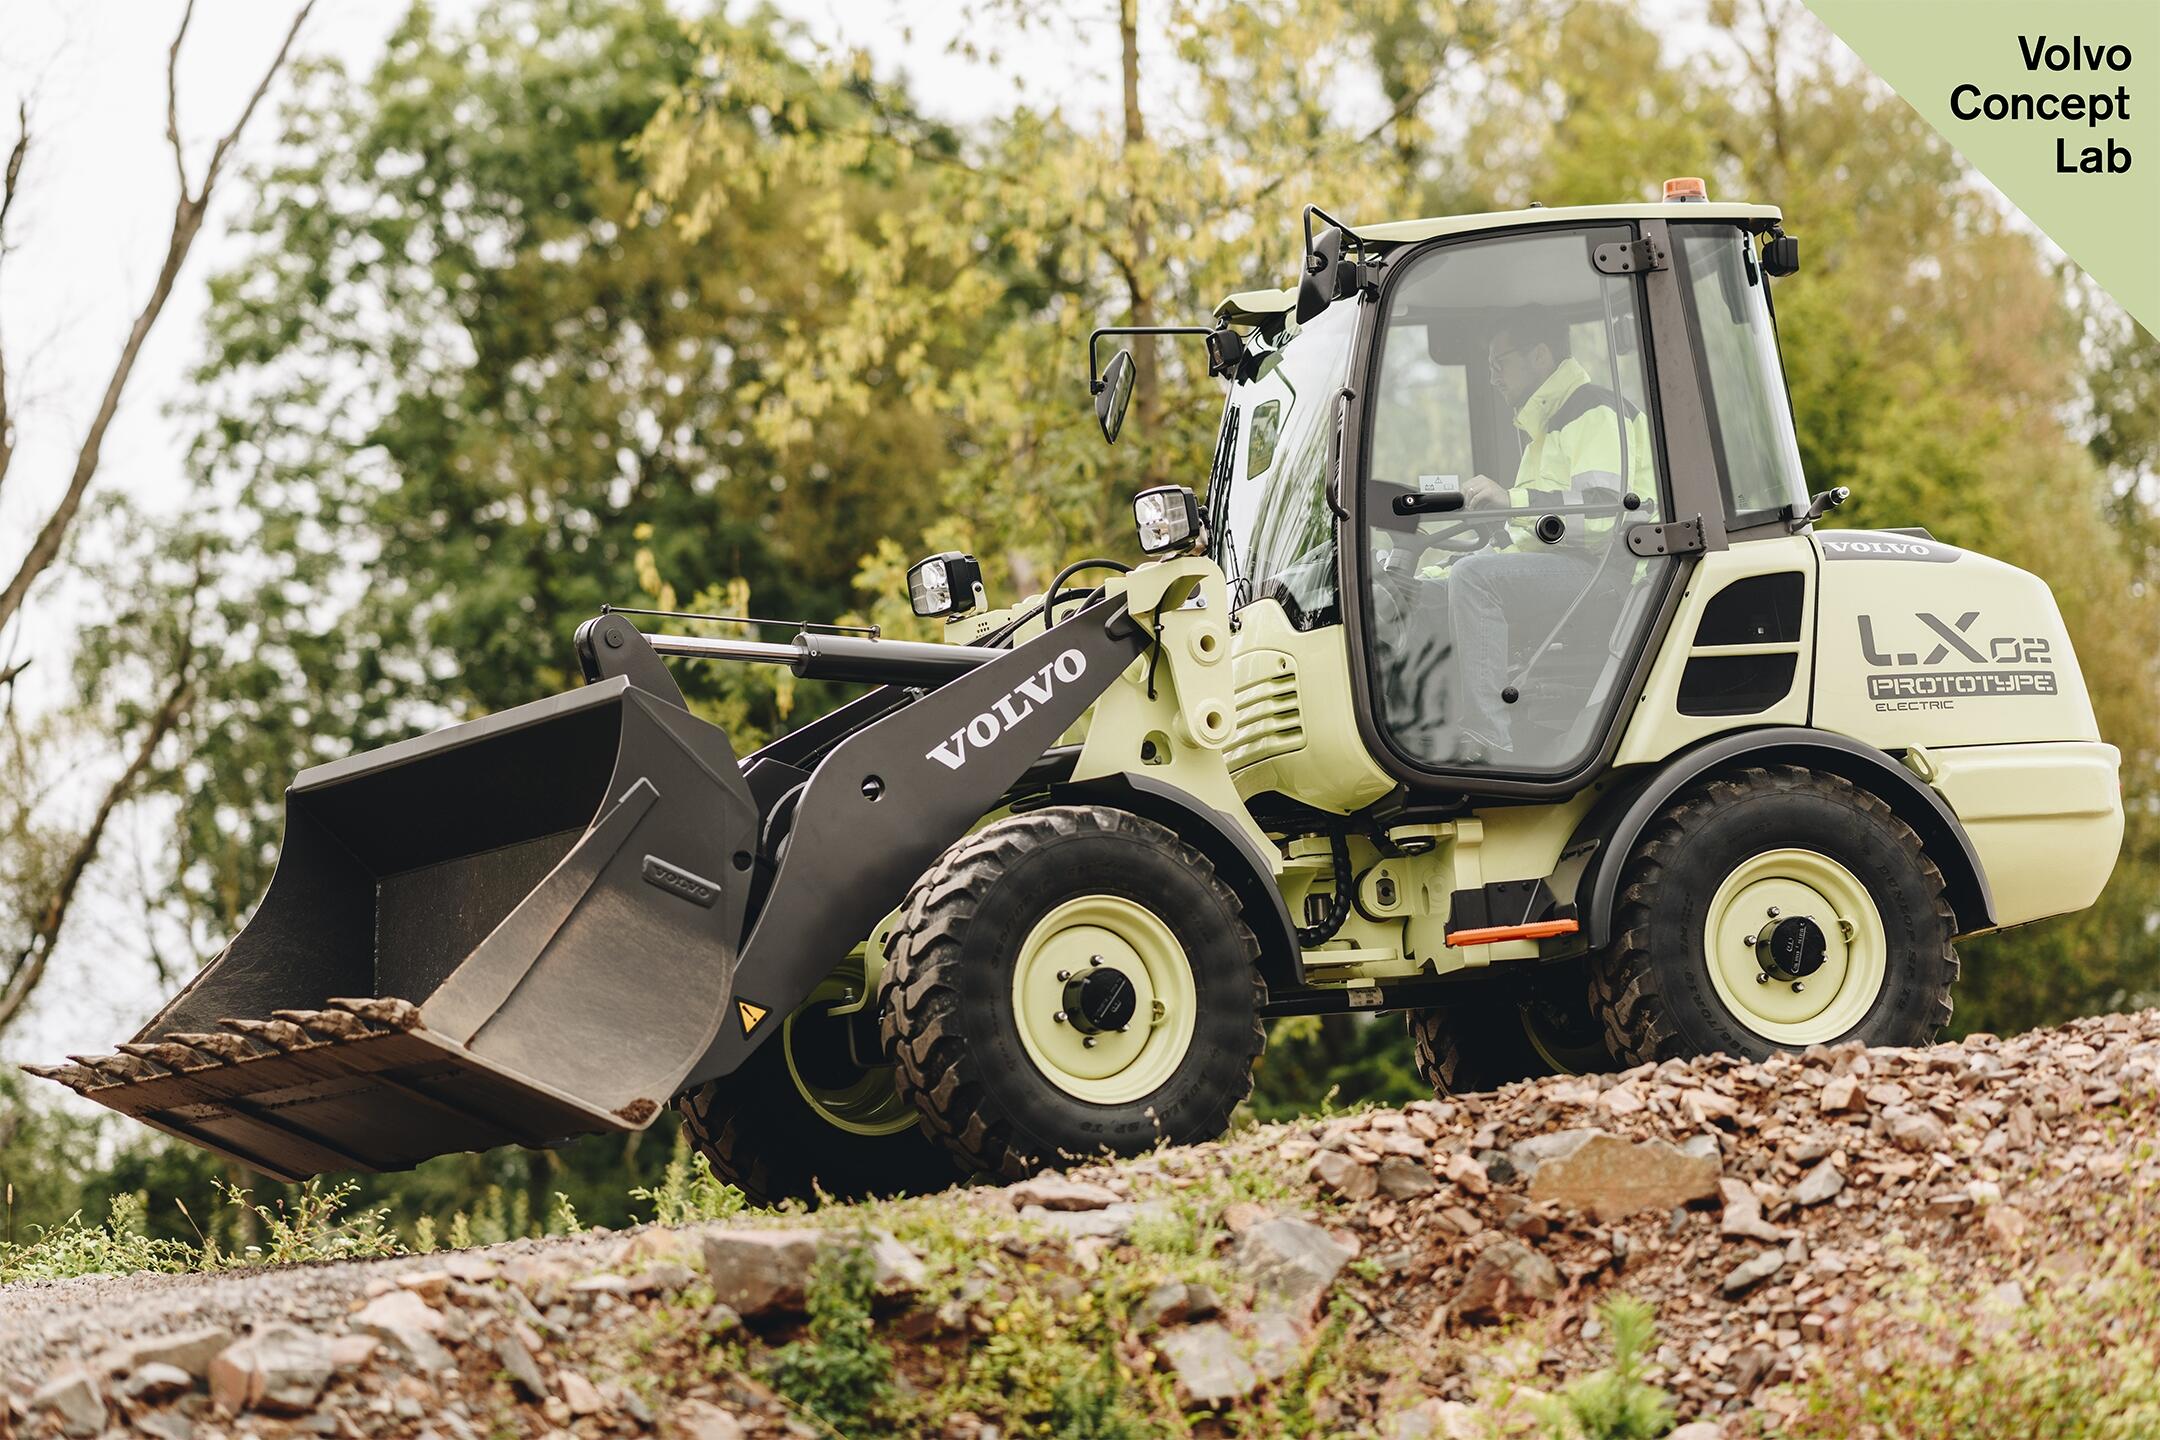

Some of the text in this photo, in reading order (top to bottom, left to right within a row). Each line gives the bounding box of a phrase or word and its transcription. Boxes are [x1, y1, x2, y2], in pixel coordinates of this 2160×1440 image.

[1823, 541, 1930, 556] VOLVO
[1872, 673, 2054, 696] PROTOTYPE
[925, 649, 1087, 770] VOLVO
[1875, 700, 1954, 712] ELECTRIC
